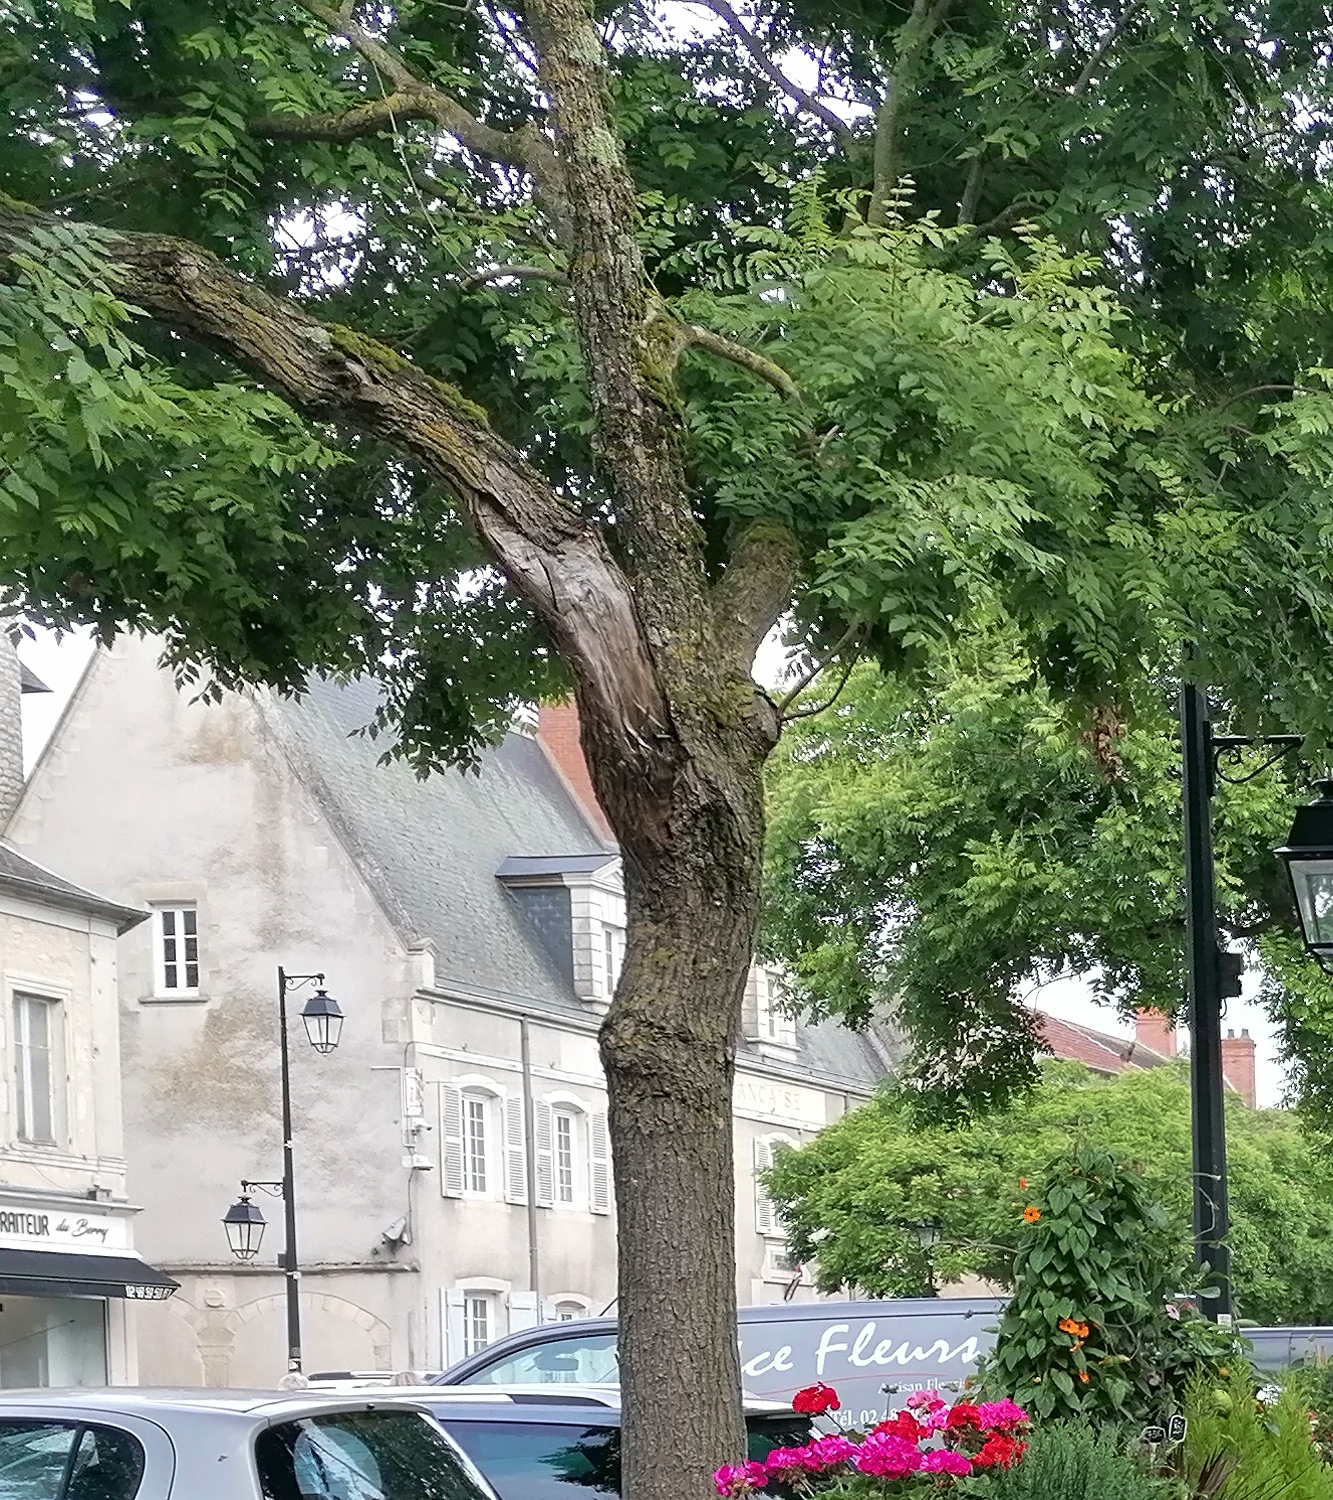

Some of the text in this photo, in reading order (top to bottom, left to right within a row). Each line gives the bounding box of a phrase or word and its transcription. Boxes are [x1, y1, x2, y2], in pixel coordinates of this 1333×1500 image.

[55, 1217, 71, 1233] du
[71, 1218, 109, 1243] Berry
[816, 1322, 980, 1375] Fleurs
[860, 1409, 878, 1425] 02
